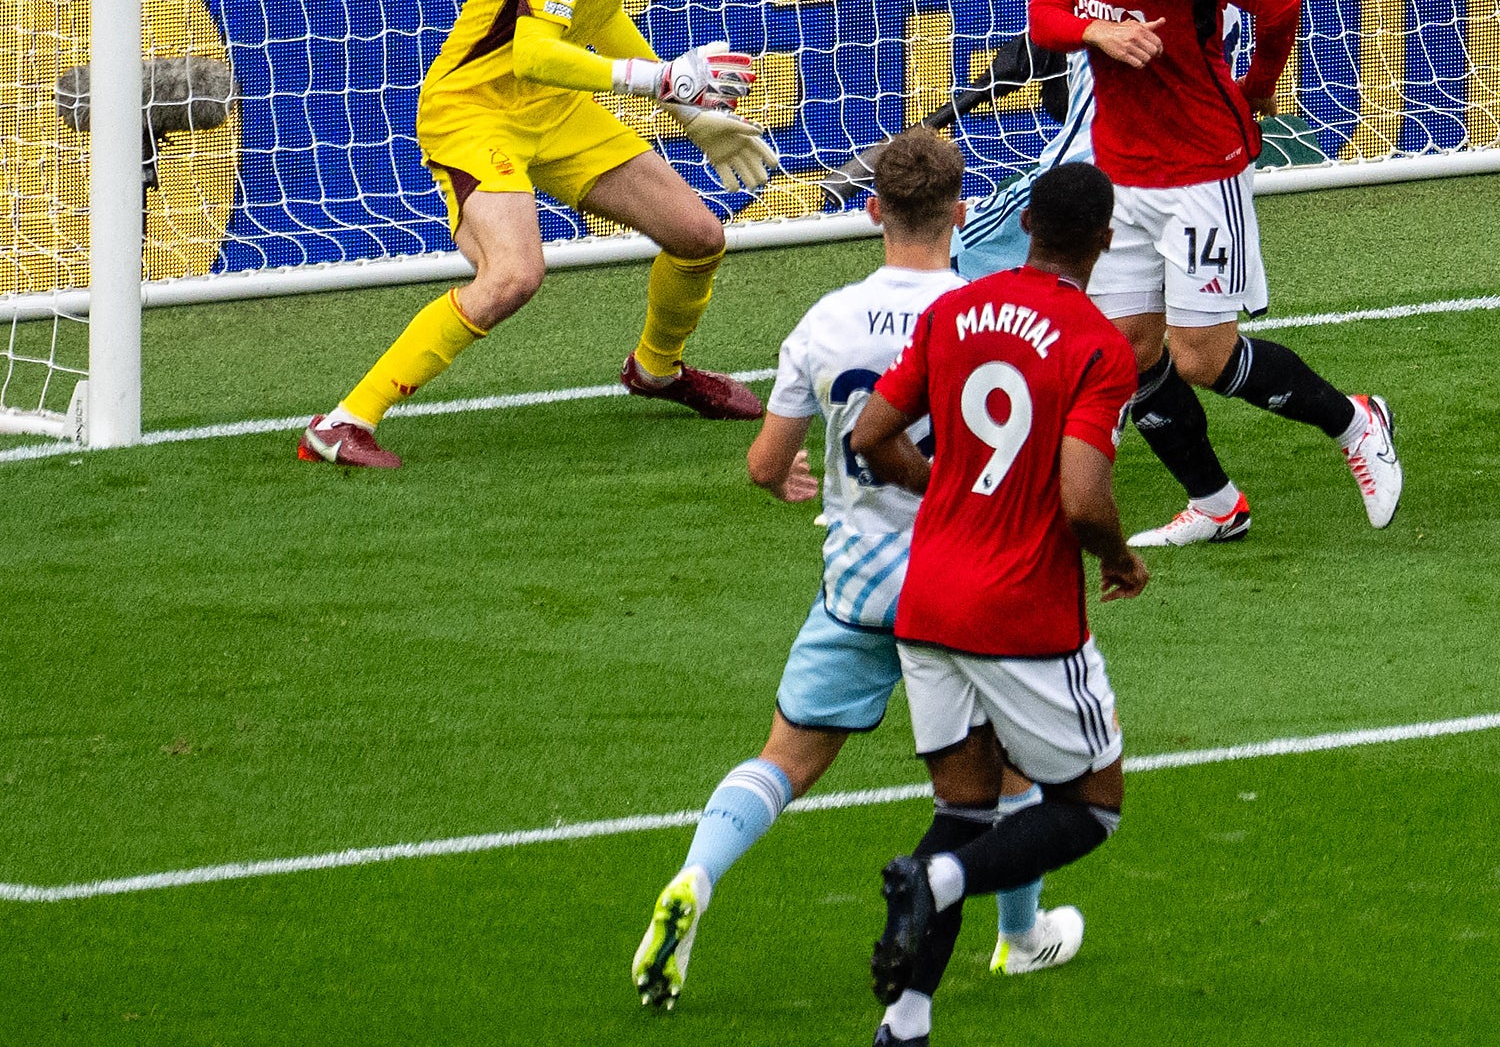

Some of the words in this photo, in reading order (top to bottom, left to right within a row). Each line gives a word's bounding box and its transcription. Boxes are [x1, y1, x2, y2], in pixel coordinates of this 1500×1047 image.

[1184, 226, 1228, 274] 14
[867, 310, 920, 336] YAT
[955, 302, 1061, 360] MARTIAL
[961, 360, 1034, 496] 9
